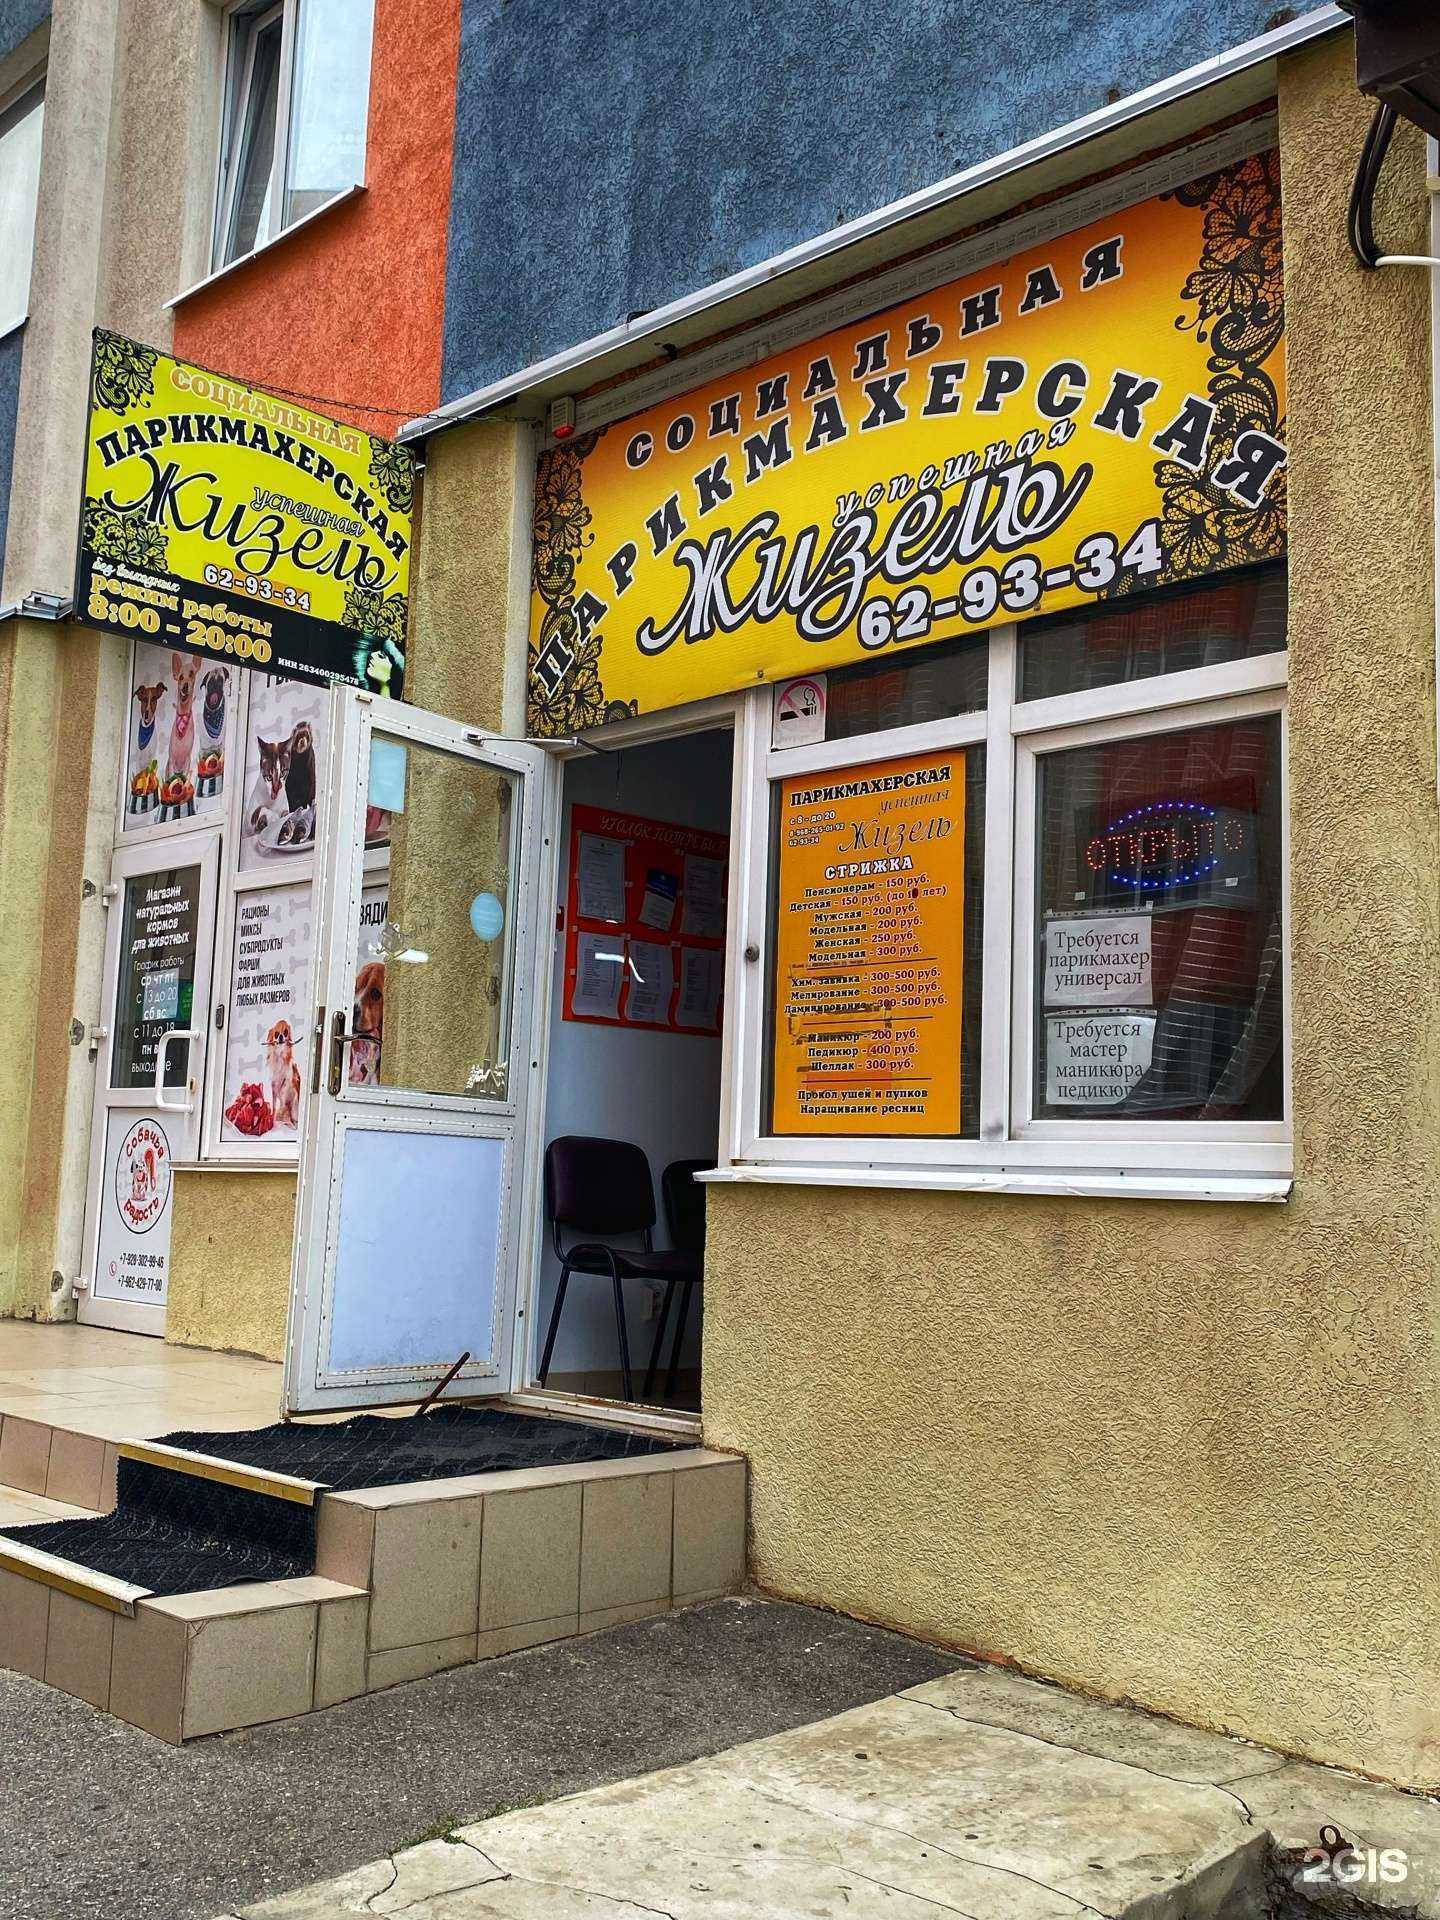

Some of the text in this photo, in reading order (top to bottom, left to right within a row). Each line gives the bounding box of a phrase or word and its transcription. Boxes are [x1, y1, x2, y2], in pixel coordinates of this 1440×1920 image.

[625, 234, 1124, 469] СОЦИАЛЬНАЯ
[170, 367, 361, 455] СОЦИАЛЬНАЯ
[835, 419, 1076, 527] успешная
[95, 414, 409, 562] ПАРИКМАХЕРСКАЯ
[104, 452, 399, 591] Жизель
[251, 487, 365, 538] успешная
[533, 356, 1288, 696] ПАРИКМАХЕРСКАЯ
[637, 457, 1093, 656] Жизель
[203, 564, 311, 611] 62-93-34
[858, 518, 1165, 651] 62-93-34
[91, 573, 272, 637] режим работы
[88, 593, 160, 634] 8:00
[186, 620, 272, 663] 20:00
[277, 657, 299, 669] ИНН
[790, 766, 952, 807] ПАРИКМАХЕРСКАЯ
[878, 790, 951, 816] успешная
[797, 815, 803, 824] 8
[811, 814, 822, 822] до
[824, 810, 836, 820] 20
[838, 817, 952, 855] Жизель
[1086, 818, 1243, 871] ОТКРЫТО
[824, 855, 913, 880] СТРИЖКА
[146, 886, 181, 902] Магазин
[805, 882, 876, 898] Пенсионерам
[886, 877, 904, 888] 150
[907, 874, 930, 887] руб.
[790, 900, 832, 912] Детская
[841, 896, 859, 906] 150
[861, 893, 883, 905] руб.
[887, 892, 904, 902] (до
[922, 886, 947, 896] лет)
[136, 900, 190, 920] натуральных
[241, 905, 270, 920] РАЦИОНЫ
[815, 911, 862, 923] Мужская
[873, 906, 892, 916] 200
[895, 903, 917, 915] руб.
[147, 918, 179, 934] кормов
[240, 923, 262, 937] МИКСЫ
[809, 924, 867, 936] Модельная
[878, 919, 897, 929] 200
[900, 916, 923, 928] руб.
[131, 932, 190, 955] для животных
[239, 937, 283, 954] СУБПРОДУКТЫ
[815, 937, 861, 948] Женская
[871, 933, 891, 943] 250
[893, 930, 916, 943] руб.
[1055, 930, 1139, 952] Требуется
[808, 950, 866, 962] Модельная
[877, 946, 896, 956] 300
[900, 943, 922, 956] руб.
[1050, 952, 1150, 972] парикмахер
[134, 955, 185, 972] График работы
[238, 958, 260, 972] ФАРШИ
[141, 974, 175, 988] ср чт пт
[236, 972, 285, 990] ДЛЯ ЖИВОТНЫХ
[791, 978, 816, 987] Хим.
[819, 975, 860, 985] завивка
[871, 970, 915, 981] 300-500
[918, 967, 941, 980] руб.
[1055, 972, 1142, 991] универсал
[136, 994, 142, 1004] с
[155, 992, 165, 1002] до
[167, 987, 177, 1000] 20
[236, 990, 290, 1007] ЛЮБЫХ РАЗМЕРОВ
[791, 989, 860, 1001] Мелирование
[871, 983, 915, 995] 300-500
[918, 981, 941, 993] руб.
[144, 1007, 167, 1019] сб вс
[784, 1002, 867, 1013] Ламинирование
[877, 997, 921, 1008] 300-500
[925, 994, 947, 1007] руб.
[133, 1028, 140, 1038] с
[142, 1024, 150, 1037] 11
[152, 1026, 163, 1038] до
[808, 1033, 860, 1043] Маникюр
[871, 1030, 891, 1040] 200
[895, 1028, 919, 1041] руб.
[1054, 1020, 1141, 1043] Требуется
[142, 1044, 152, 1055] пн
[808, 1047, 859, 1058] Педикюр
[870, 1044, 891, 1055] 400
[894, 1043, 918, 1056] руб.
[1070, 1044, 1128, 1062] мастер
[131, 1060, 171, 1073] выходе
[811, 1062, 854, 1071] Шеллак
[866, 1060, 886, 1069] 300
[890, 1058, 914, 1071] руб.
[1056, 1064, 1144, 1082] маникюра
[798, 1088, 928, 1100] Прокол ушей и пупков
[801, 1105, 925, 1115] Наращивание ресниц
[126, 1127, 165, 1159] Собачья
